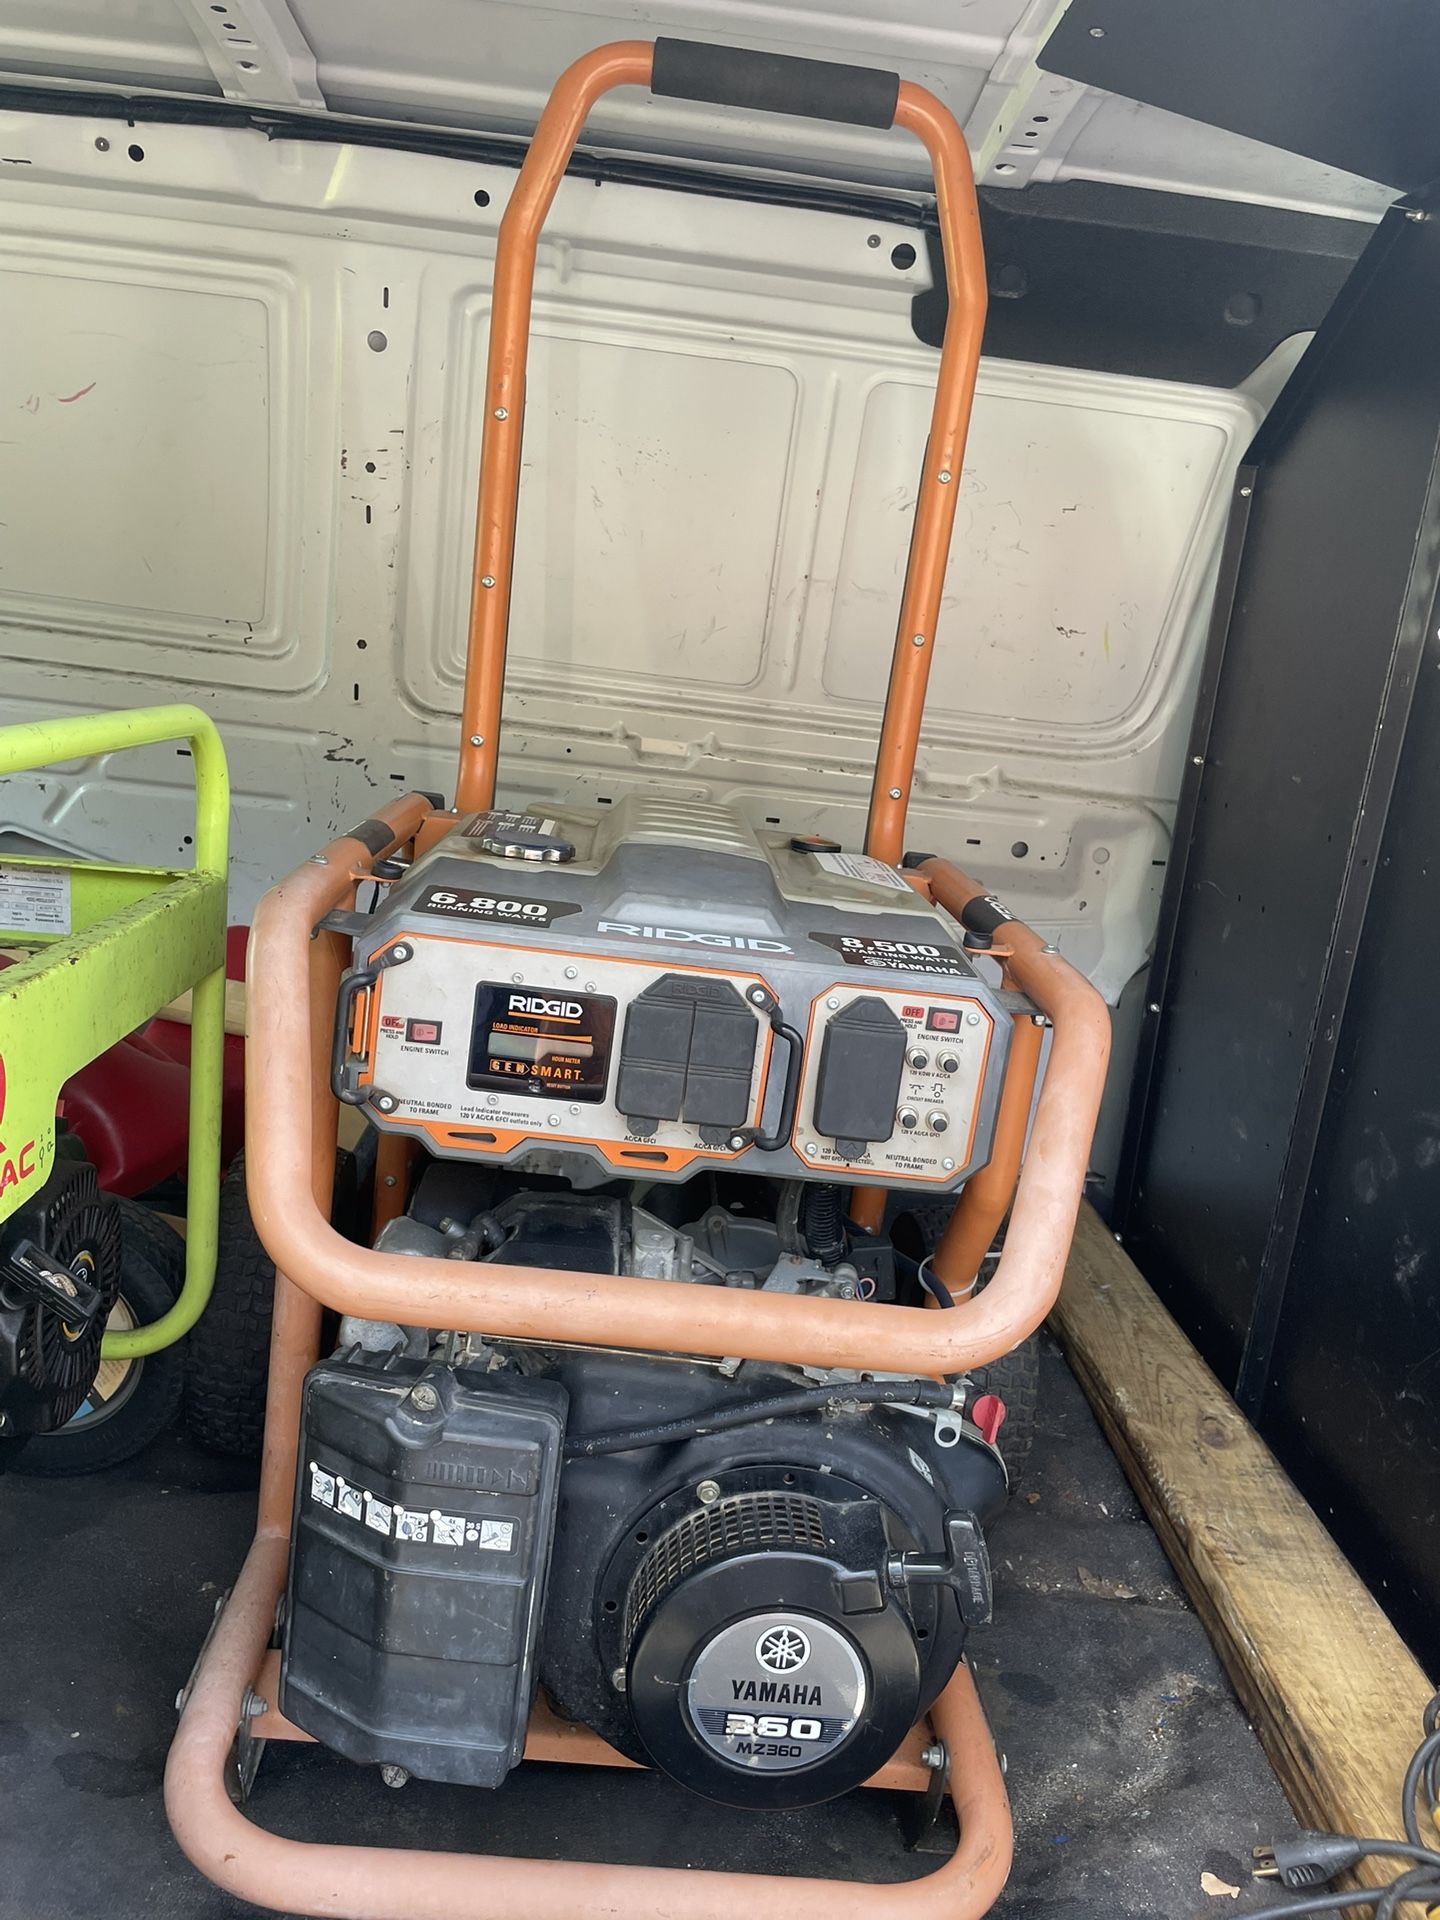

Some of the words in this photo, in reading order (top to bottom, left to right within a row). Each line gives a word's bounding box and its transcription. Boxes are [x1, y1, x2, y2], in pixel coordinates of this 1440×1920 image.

[430, 892, 548, 916] 6,800
[427, 902, 493, 915] RUNNING
[498, 912, 547, 922] WATTS
[597, 921, 794, 954] RIDGID
[841, 937, 940, 957] 8,500
[842, 947, 907, 959] STARTING
[910, 955, 958, 964] WATTS
[887, 961, 961, 976] YAMAHA
[508, 994, 583, 1018] RIDGID
[905, 1008, 921, 1017] OFF
[492, 1022, 508, 1030] LOAD
[508, 1024, 538, 1034] INDICATOR
[917, 1033, 939, 1041] ENGINE
[940, 1036, 964, 1044] SWITCH
[400, 1045, 423, 1053] ENGINE
[425, 1048, 449, 1056] SWITCH
[492, 1060, 525, 1073] GEN
[530, 1064, 582, 1080] SMART
[398, 1099, 425, 1107] NEUTRAL
[426, 1101, 452, 1110] BONDED
[475, 1107, 501, 1115] Indicator
[624, 1135, 642, 1143] AC/CA
[885, 1154, 911, 1162] NEUTRAL
[904, 1162, 924, 1170] FRAME
[731, 1679, 822, 1706] YAMAHA
[726, 1713, 822, 1740] 360
[735, 1742, 802, 1757] MZ360
